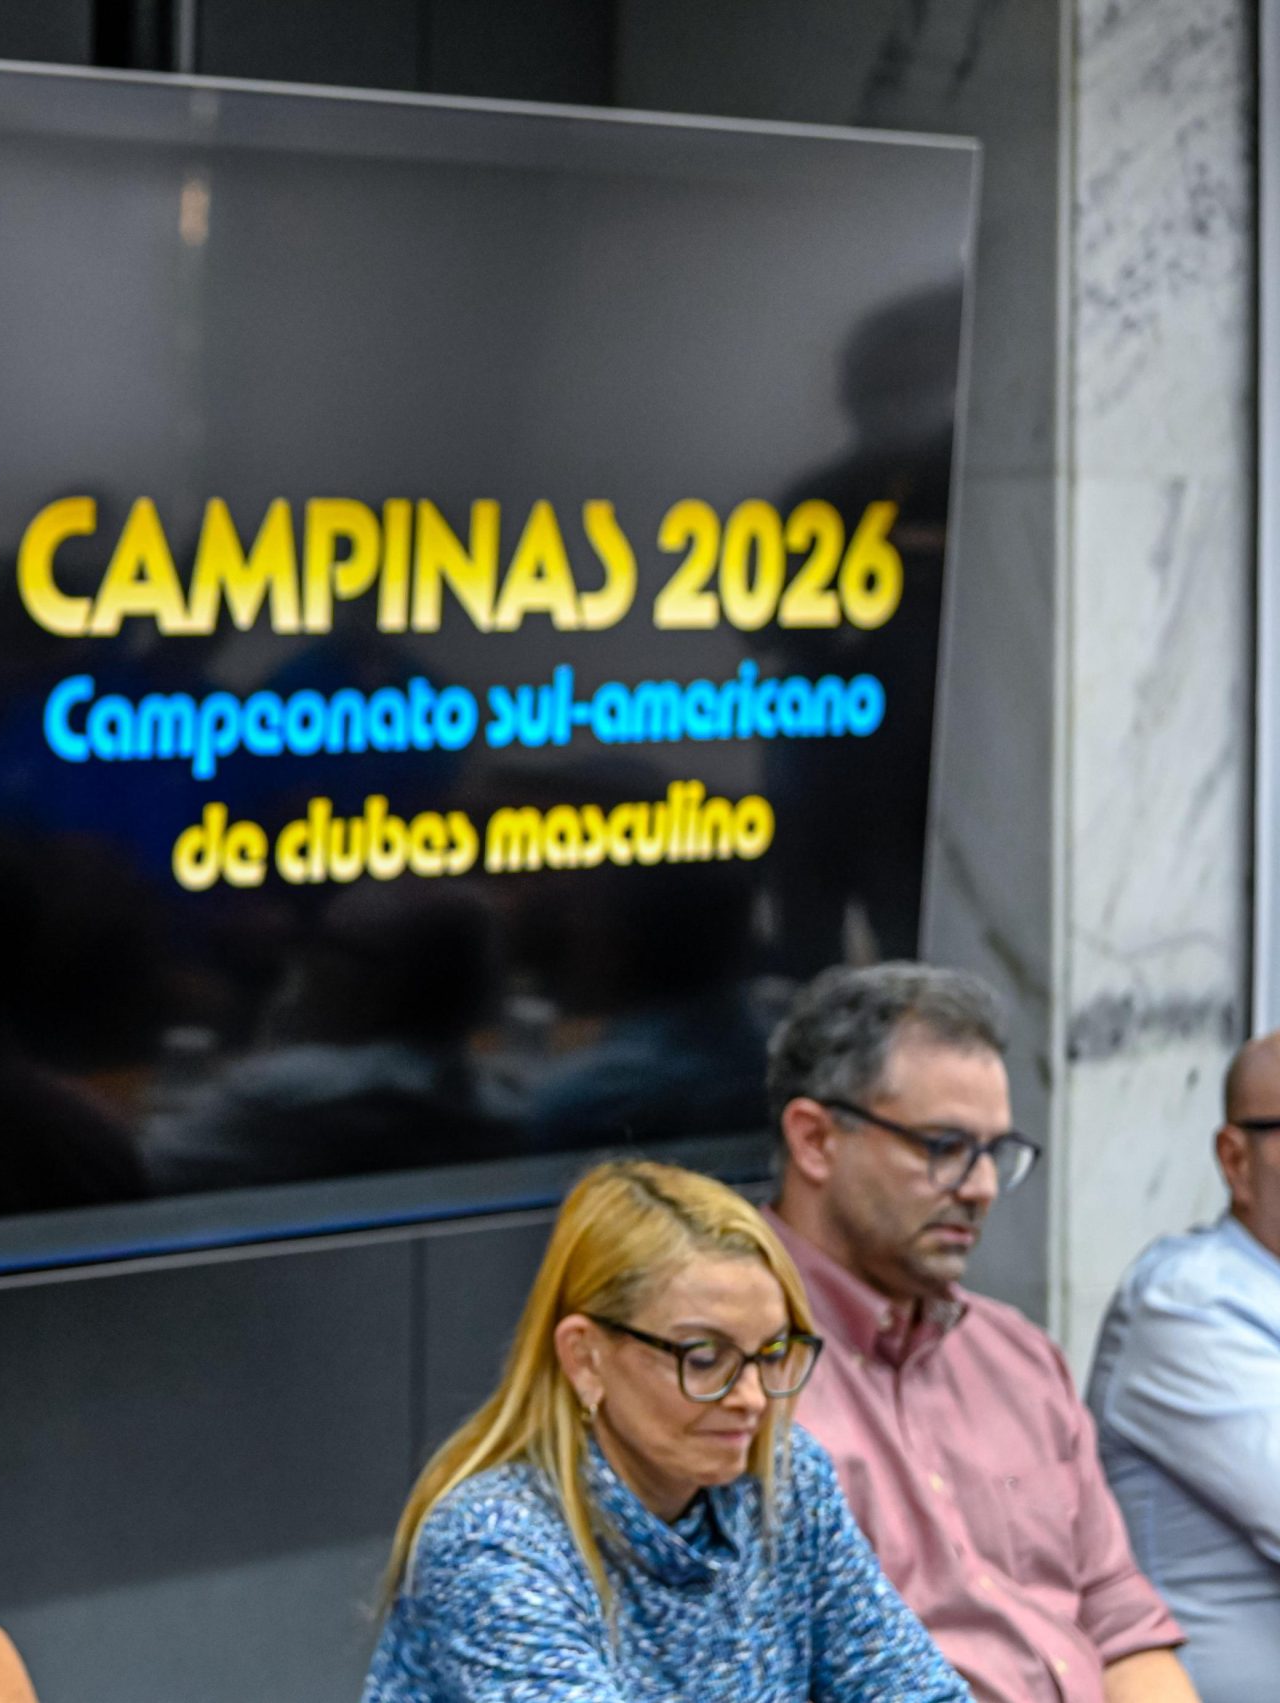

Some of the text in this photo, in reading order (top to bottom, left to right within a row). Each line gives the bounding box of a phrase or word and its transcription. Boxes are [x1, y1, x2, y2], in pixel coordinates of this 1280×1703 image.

[17, 496, 904, 637] CAMPINAS 2026
[43, 658, 886, 780] Campeonato sul-americano
[172, 779, 776, 891] de clubes masculino
